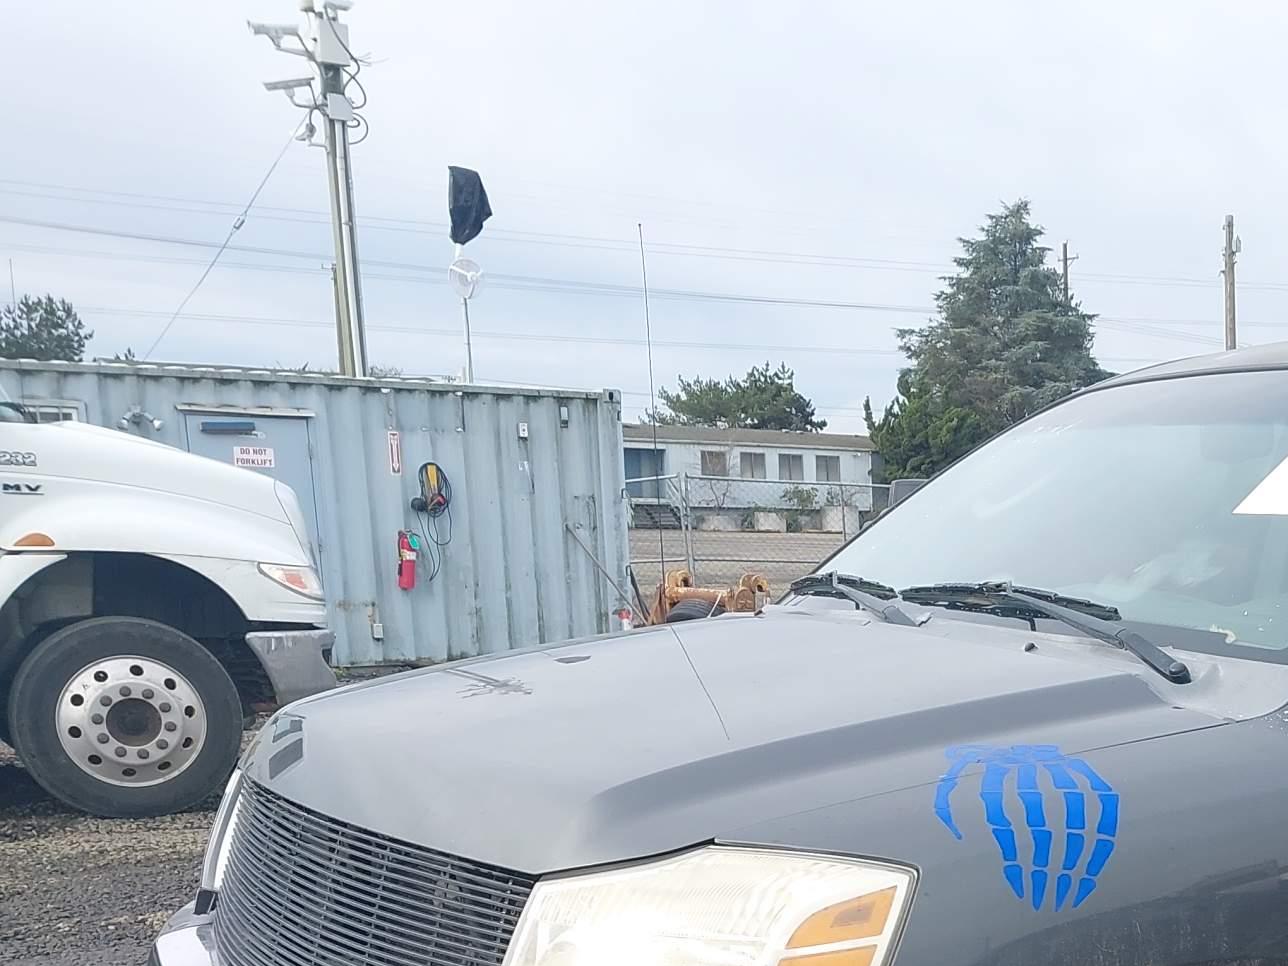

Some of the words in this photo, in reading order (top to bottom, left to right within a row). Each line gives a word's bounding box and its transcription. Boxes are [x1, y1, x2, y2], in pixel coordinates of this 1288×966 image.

[240, 447, 250, 455] DO
[252, 448, 267, 456] NOT
[236, 457, 272, 466] FORKLIFT
[2, 483, 42, 492] MV
